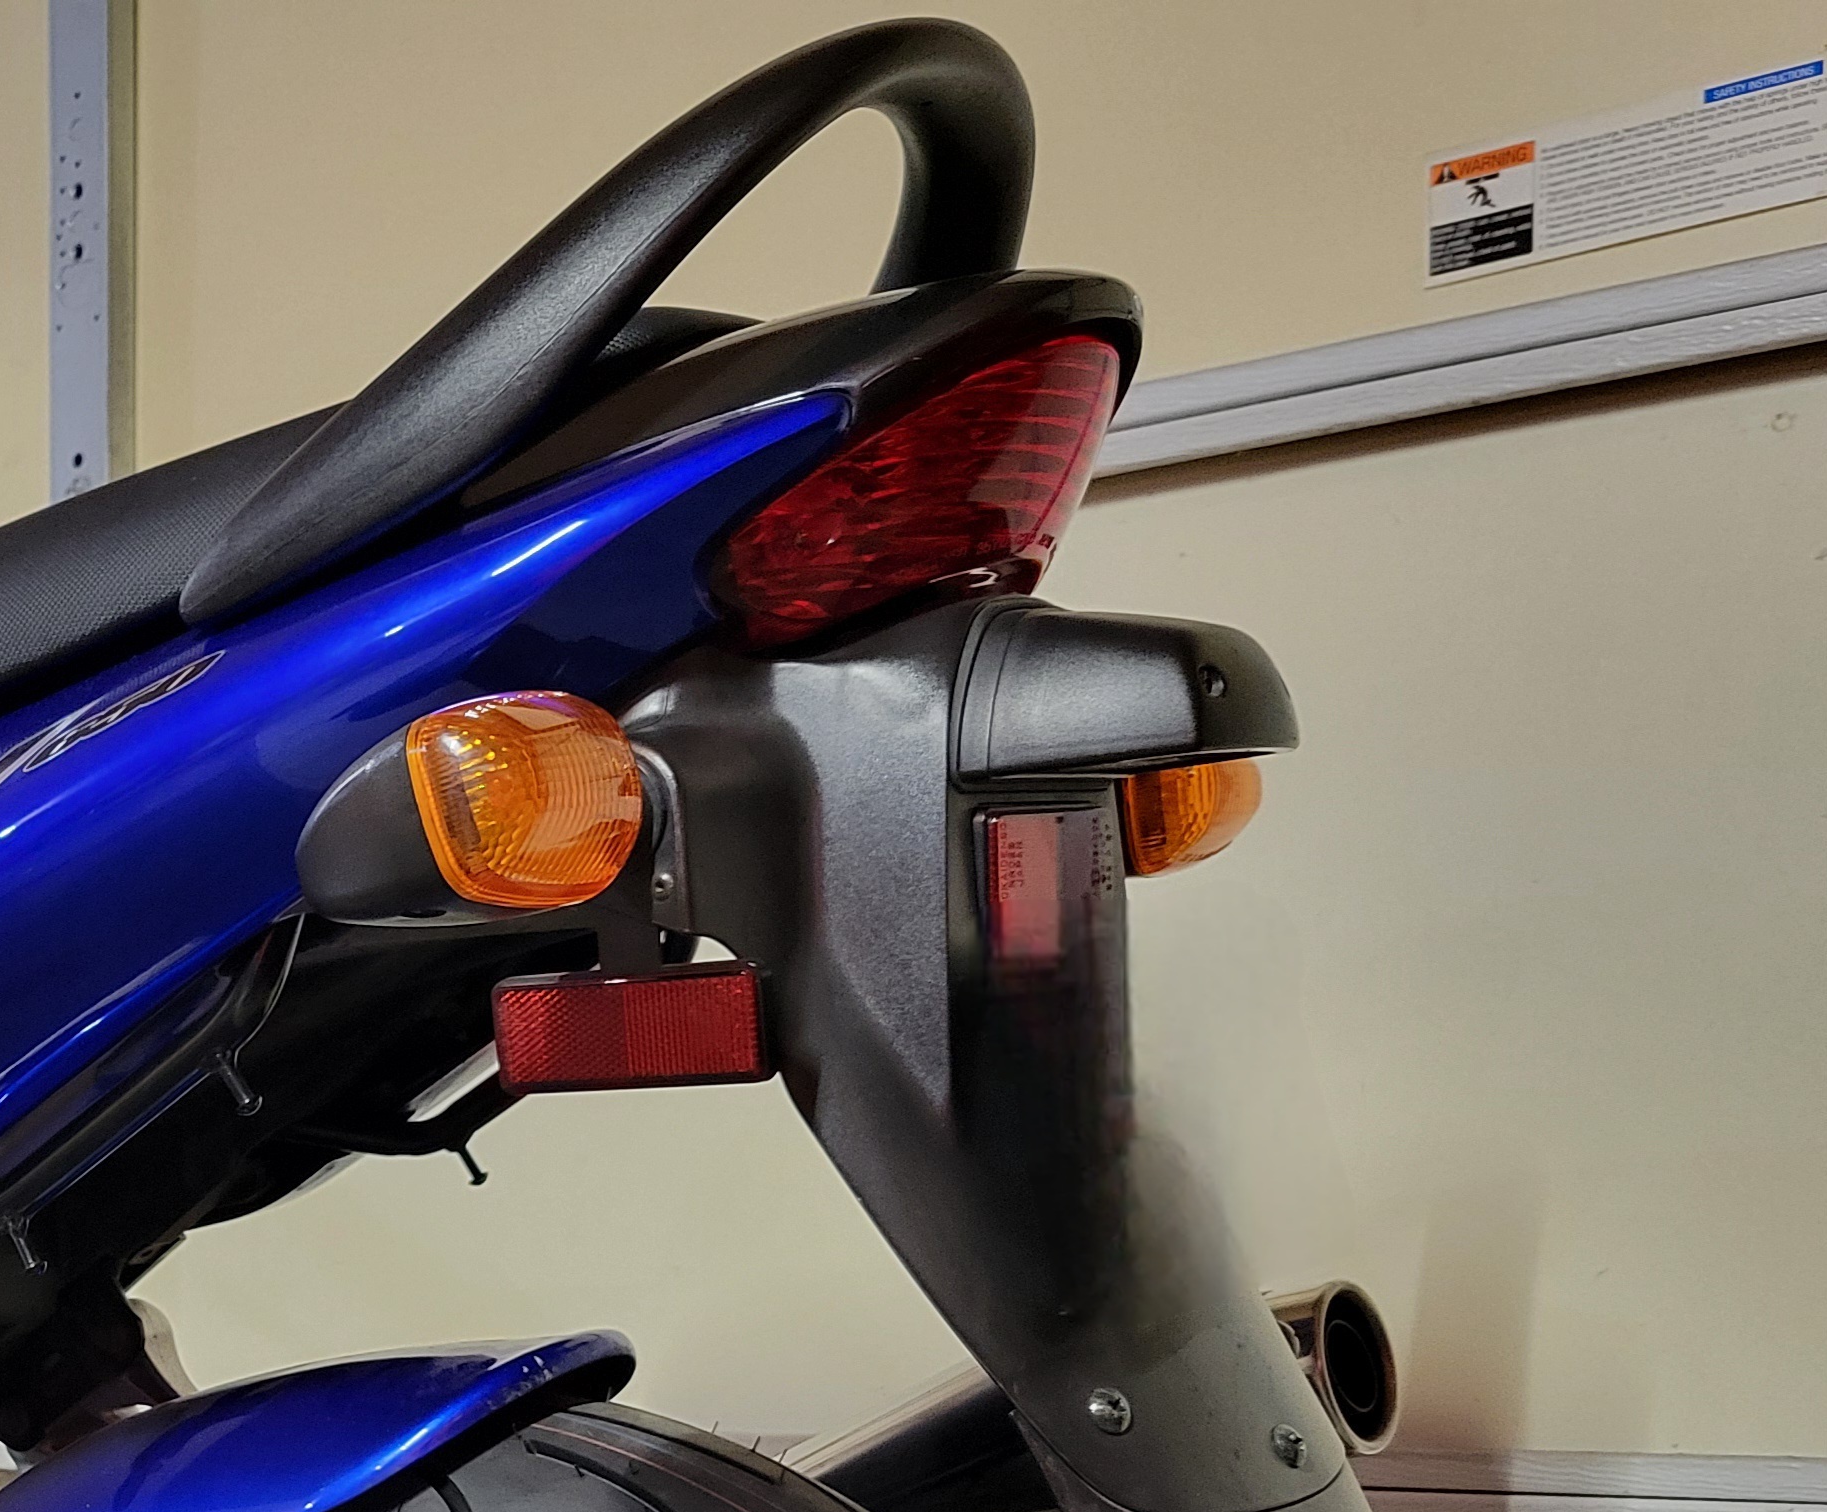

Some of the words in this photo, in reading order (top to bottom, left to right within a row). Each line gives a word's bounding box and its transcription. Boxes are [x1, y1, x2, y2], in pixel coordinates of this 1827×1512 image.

[1713, 82, 1746, 100] SAFETY
[1747, 65, 1815, 90] INSTRUCTIONS
[1458, 146, 1527, 176] WARNING
